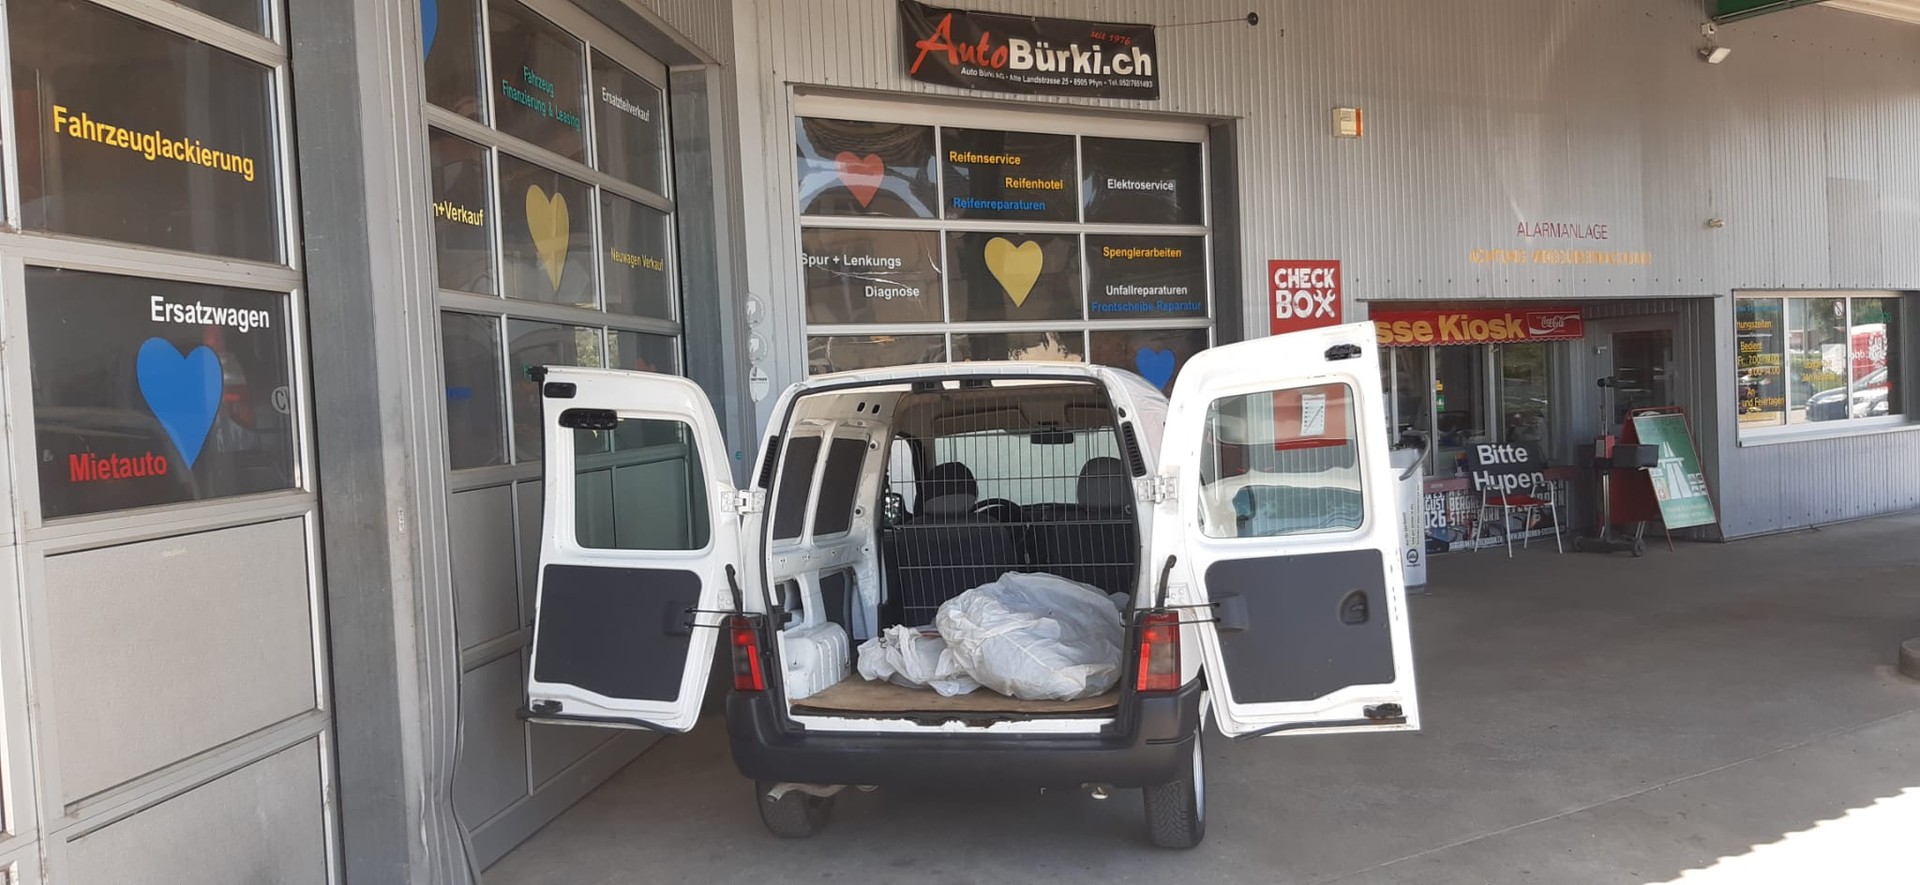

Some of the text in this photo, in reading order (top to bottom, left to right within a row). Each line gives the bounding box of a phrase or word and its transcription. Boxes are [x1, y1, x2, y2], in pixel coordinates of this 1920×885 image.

[910, 13, 1152, 76] AutoBürki.ch
[523, 66, 554, 98] Fahrzeug
[960, 67, 977, 76] Auto
[1023, 75, 1060, 85] Landstrasse
[1089, 79, 1103, 88] Pfyn
[502, 80, 581, 131] Finanzierung & Leasing
[602, 87, 650, 123] Ersatzteilverkauf
[53, 105, 255, 182] Fahrzeuglackierung
[949, 151, 1021, 166] Reifenservice
[1005, 177, 1064, 191] Reifenhotel
[1107, 178, 1174, 191] Elektroservice
[953, 197, 1046, 212] Reifenreparaturen
[1517, 222, 1608, 239] ALARMANLAGE
[610, 248, 664, 272] Neuwagen Verkauf
[801, 252, 902, 269] Spur + Lenkungs
[1103, 246, 1182, 261] Spenglerarbeiten
[1274, 267, 1336, 289] CHECK
[865, 285, 920, 299] Diagnose
[1105, 284, 1188, 298] Unfallreparaturen
[151, 295, 270, 333] Ersatzwagen
[1156, 300, 1201, 312] Reparatur
[1276, 289, 1336, 319] BOX
[1438, 314, 1526, 342] Kiosk
[1476, 443, 1528, 465] Bitte
[69, 451, 168, 483] Mietauto
[1473, 470, 1546, 494] Hupen
